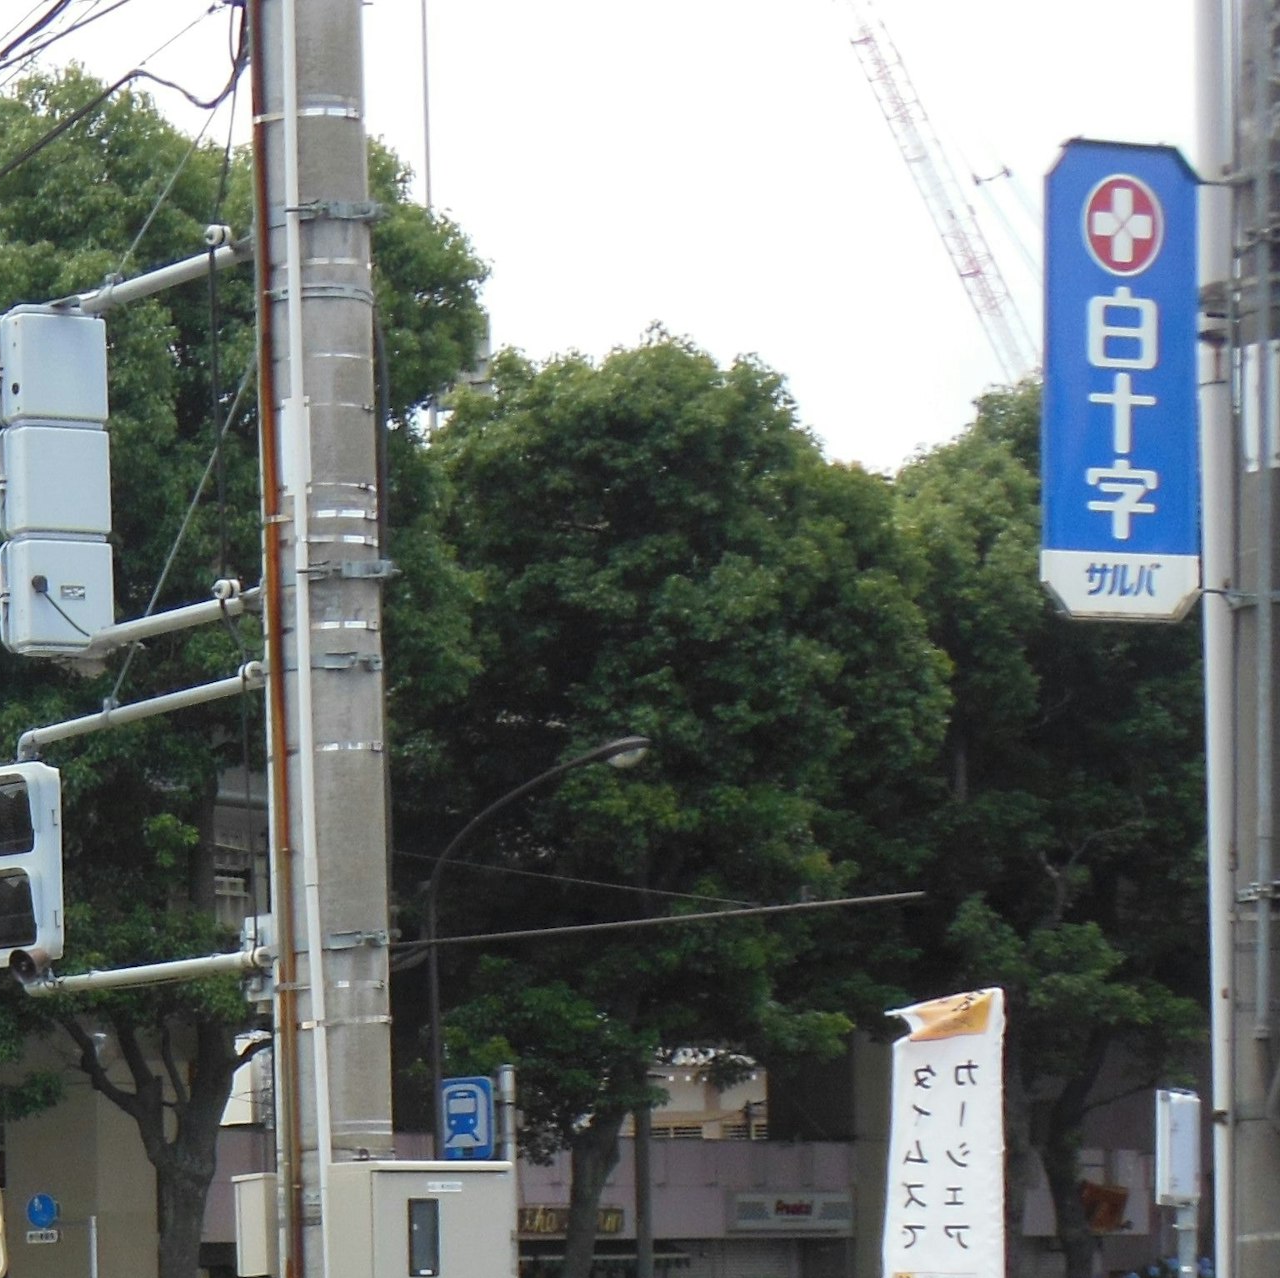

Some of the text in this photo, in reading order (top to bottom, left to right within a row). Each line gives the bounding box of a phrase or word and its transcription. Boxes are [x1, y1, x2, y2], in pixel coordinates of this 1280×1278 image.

[1085, 286, 1160, 540] 白十字
[1085, 562, 1161, 598] サルバ
